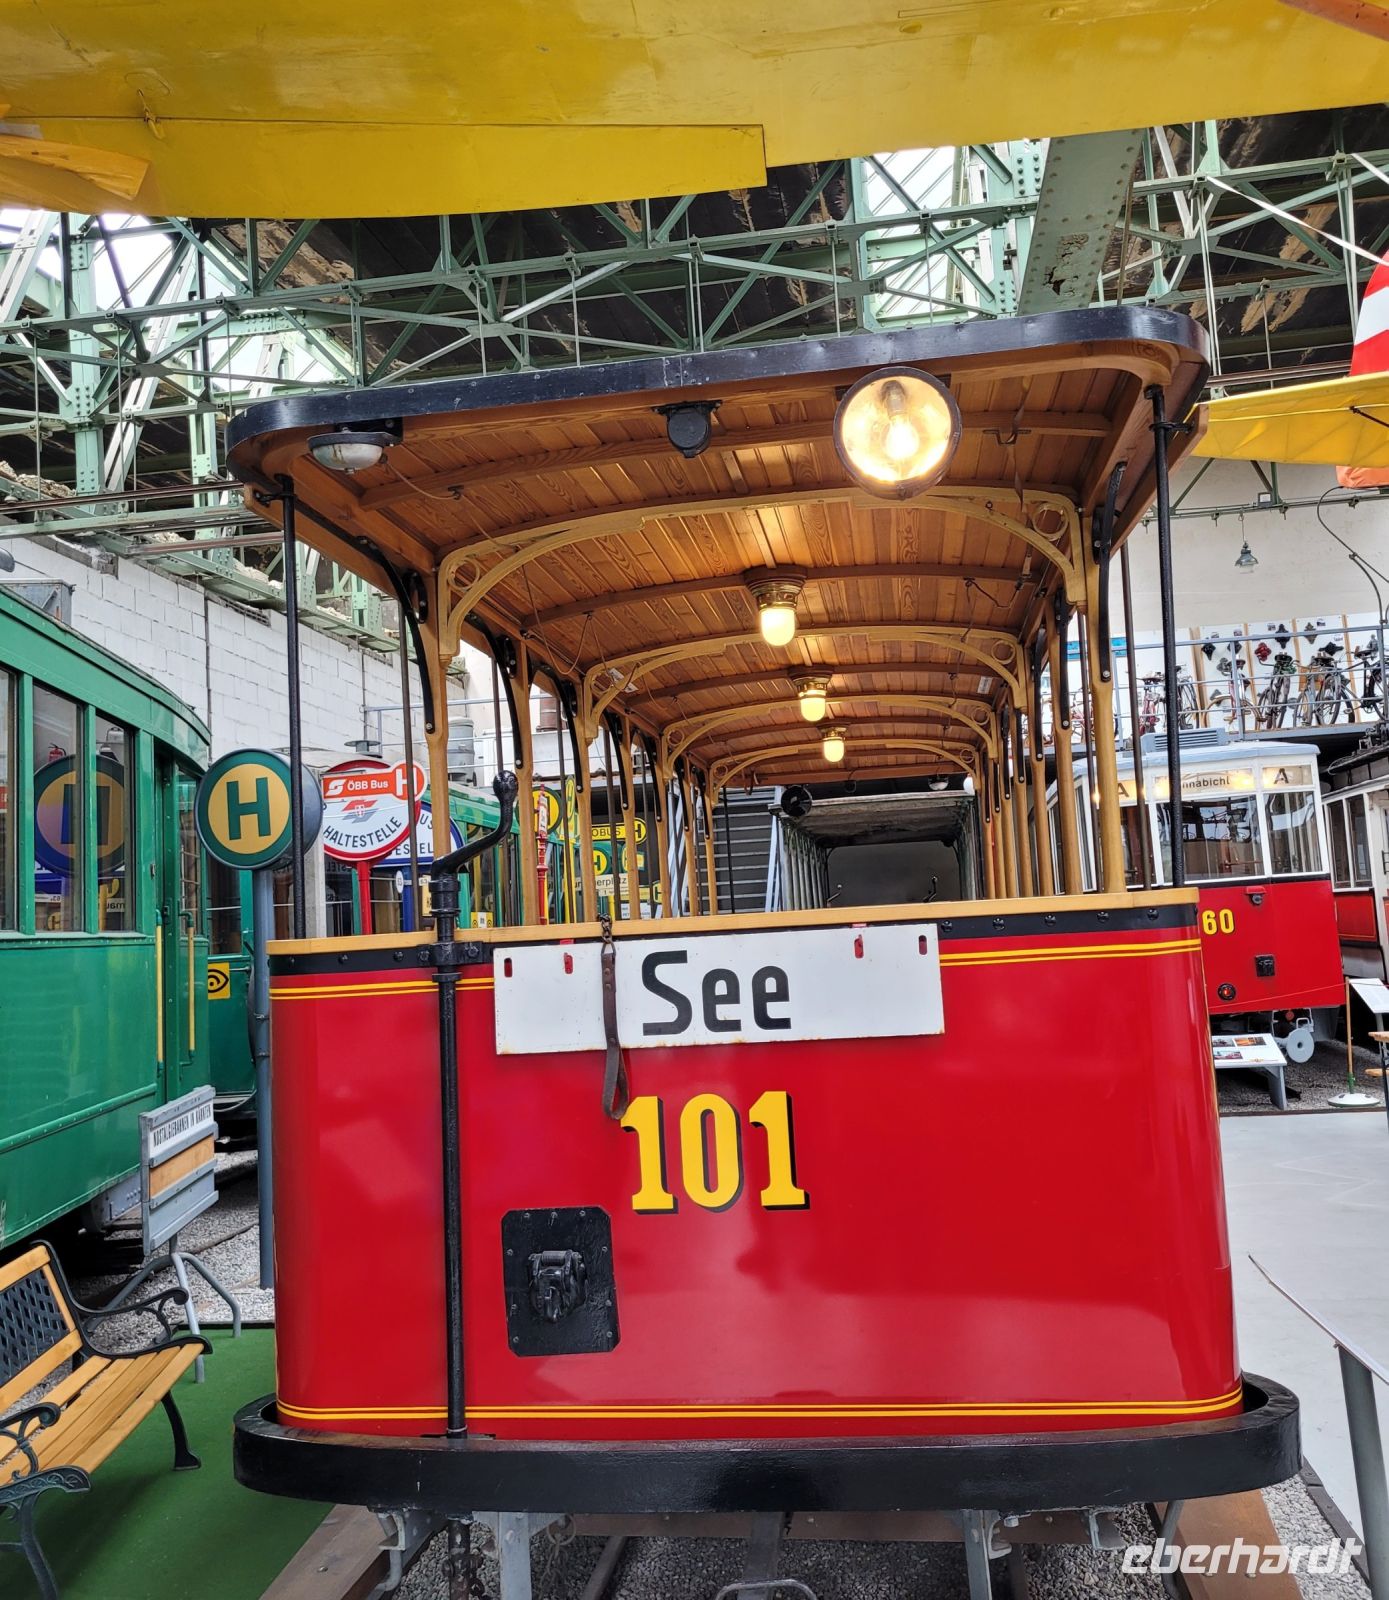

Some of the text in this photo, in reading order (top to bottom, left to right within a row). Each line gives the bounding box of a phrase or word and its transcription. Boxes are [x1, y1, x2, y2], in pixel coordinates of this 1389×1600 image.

[347, 779, 389, 791] ÖBB Bus
[1182, 776, 1231, 789] nnabichl
[1273, 767, 1289, 785] A
[226, 777, 271, 841] H
[323, 816, 402, 848] HALTESTELLE
[1201, 909, 1236, 936] 60
[641, 949, 793, 1037] See
[619, 1090, 810, 1215] 101
